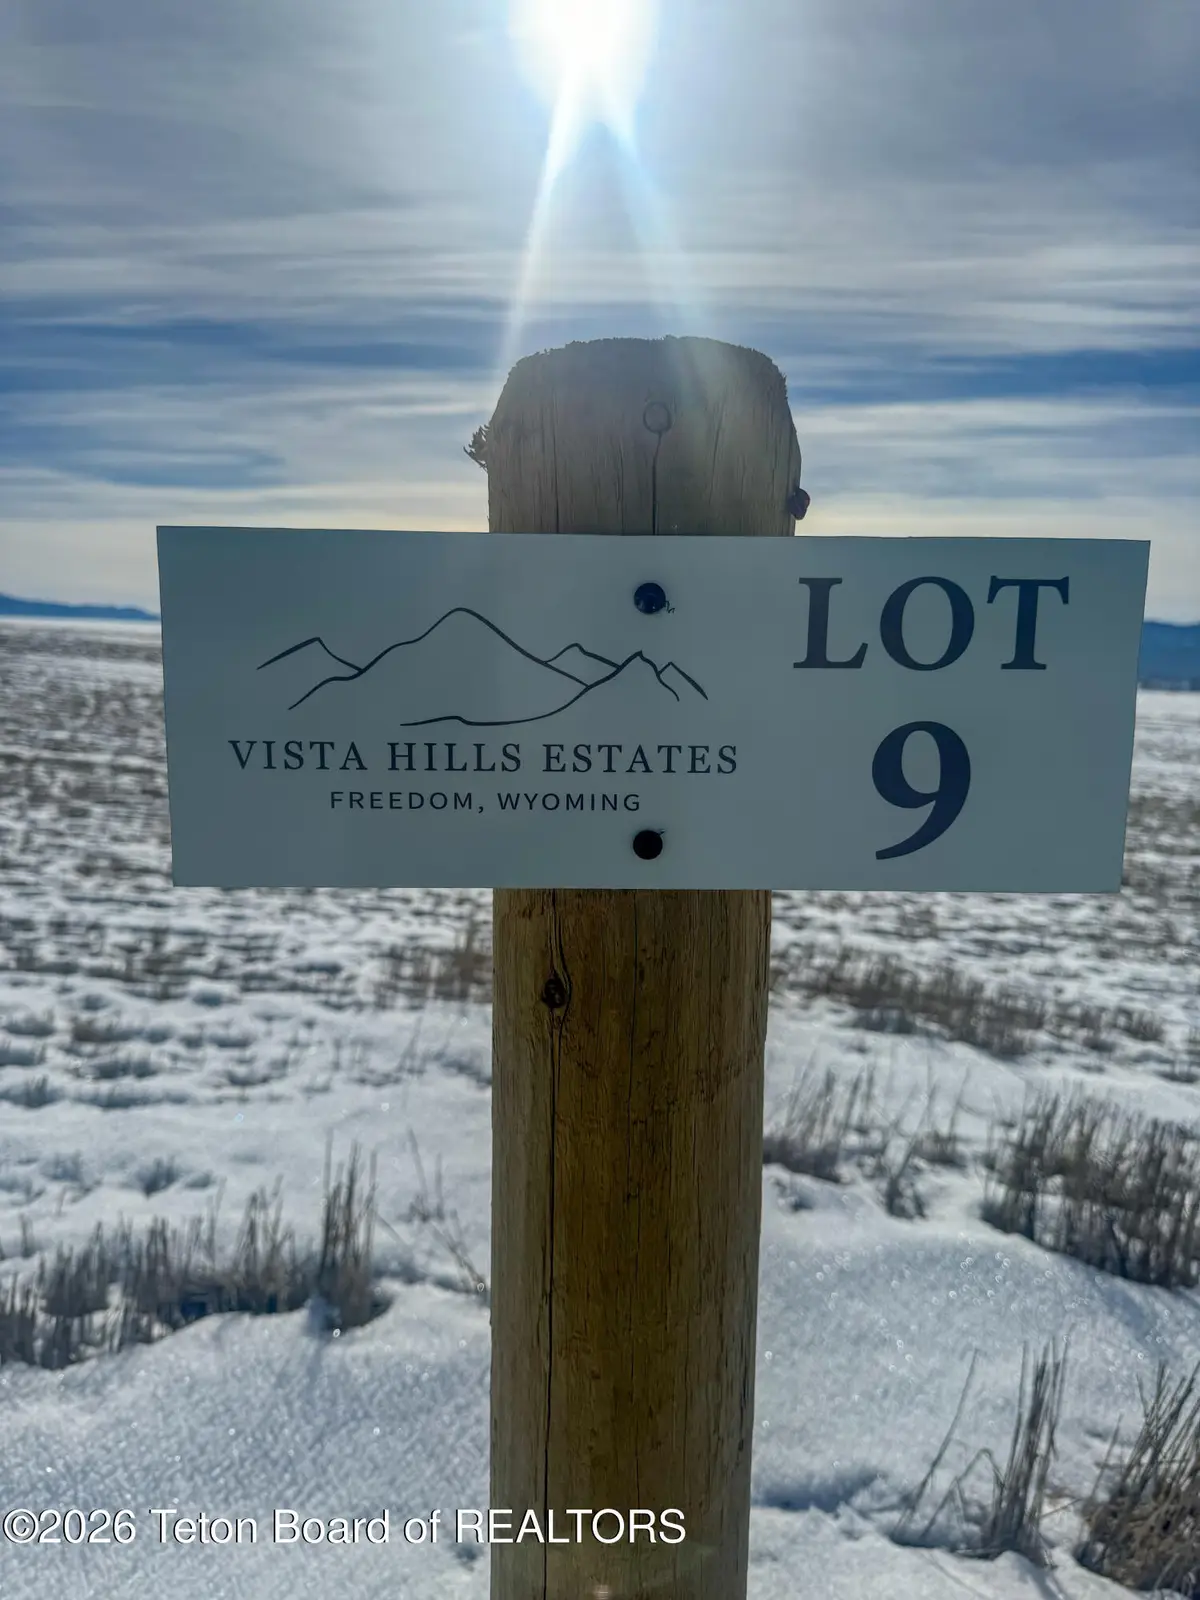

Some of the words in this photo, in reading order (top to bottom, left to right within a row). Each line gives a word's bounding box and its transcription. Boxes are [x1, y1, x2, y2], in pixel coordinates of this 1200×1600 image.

[793, 575, 1069, 672] LOT
[228, 739, 368, 771] VISTA
[387, 742, 521, 773] HILLS
[542, 744, 738, 775] ESTATES
[871, 720, 972, 860] 9
[330, 791, 485, 814] FREEDOM,
[497, 792, 641, 812] WYOMING
